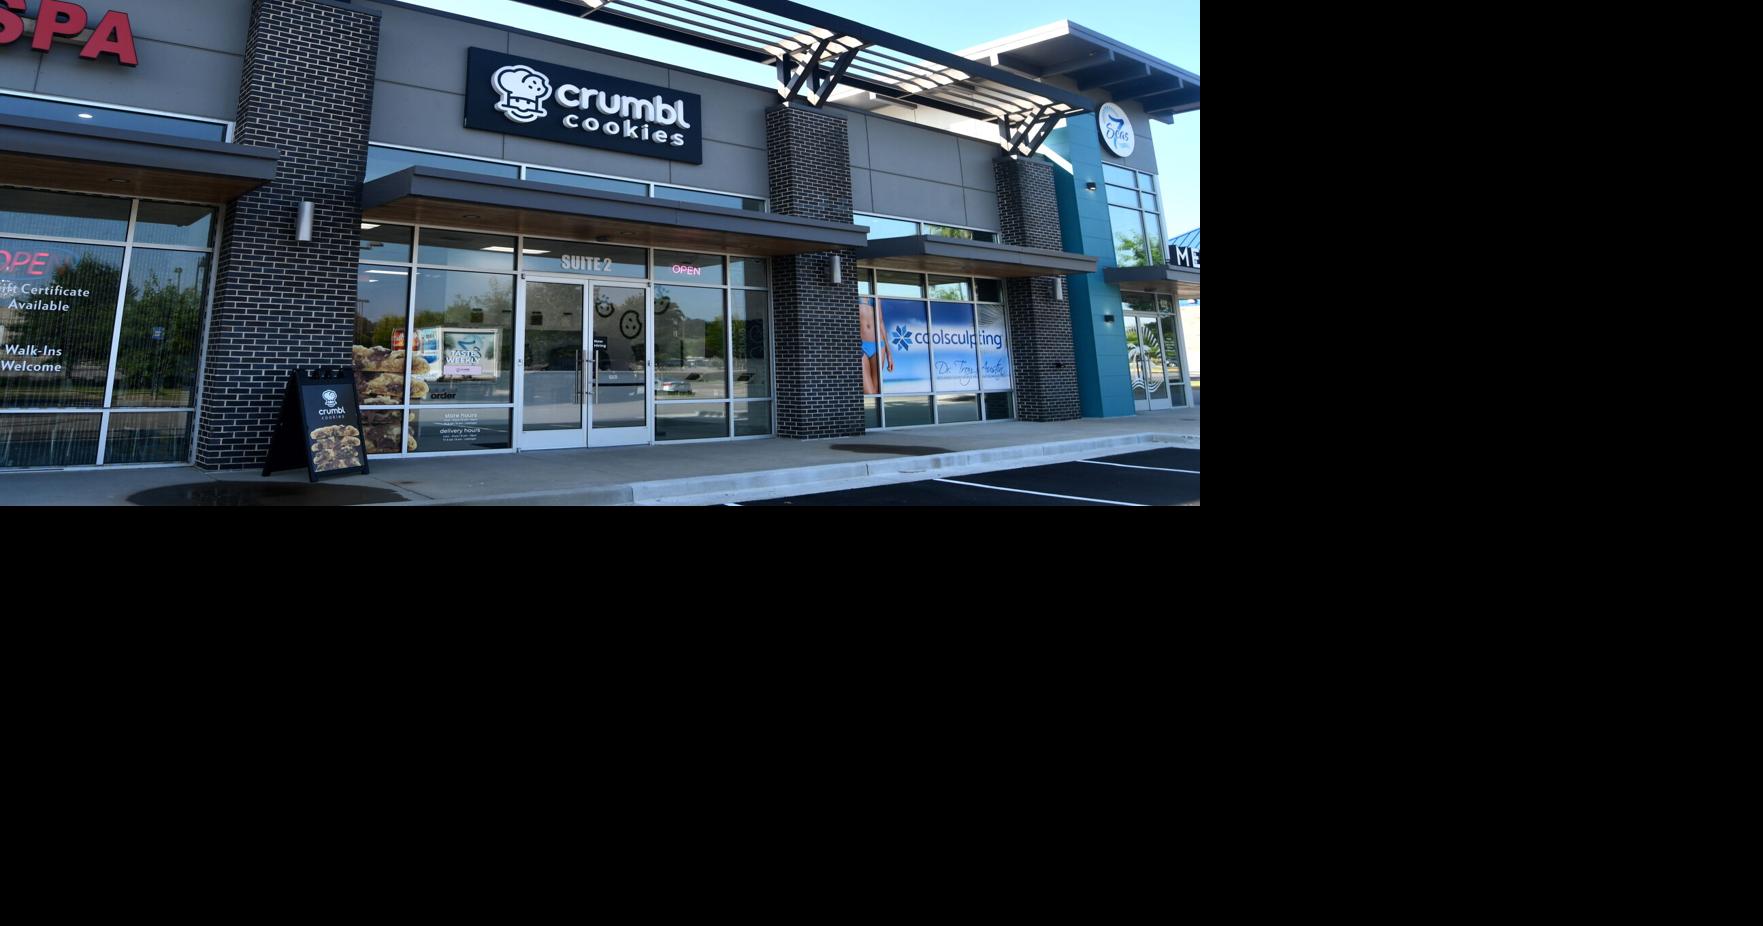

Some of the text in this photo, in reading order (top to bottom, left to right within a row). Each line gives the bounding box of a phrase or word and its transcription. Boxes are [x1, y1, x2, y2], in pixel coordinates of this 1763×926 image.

[555, 84, 690, 129] crumbl
[563, 114, 684, 146] cookies
[561, 254, 612, 272] SUITE 2
[672, 264, 701, 276] OPEN
[21, 284, 90, 297] Certificate
[8, 298, 70, 312] Available
[915, 330, 1002, 349] coolsculpting
[5, 344, 62, 356] Walk-Ins
[0, 360, 62, 372] Welcome
[431, 392, 456, 400] order
[318, 406, 346, 416] crumbl
